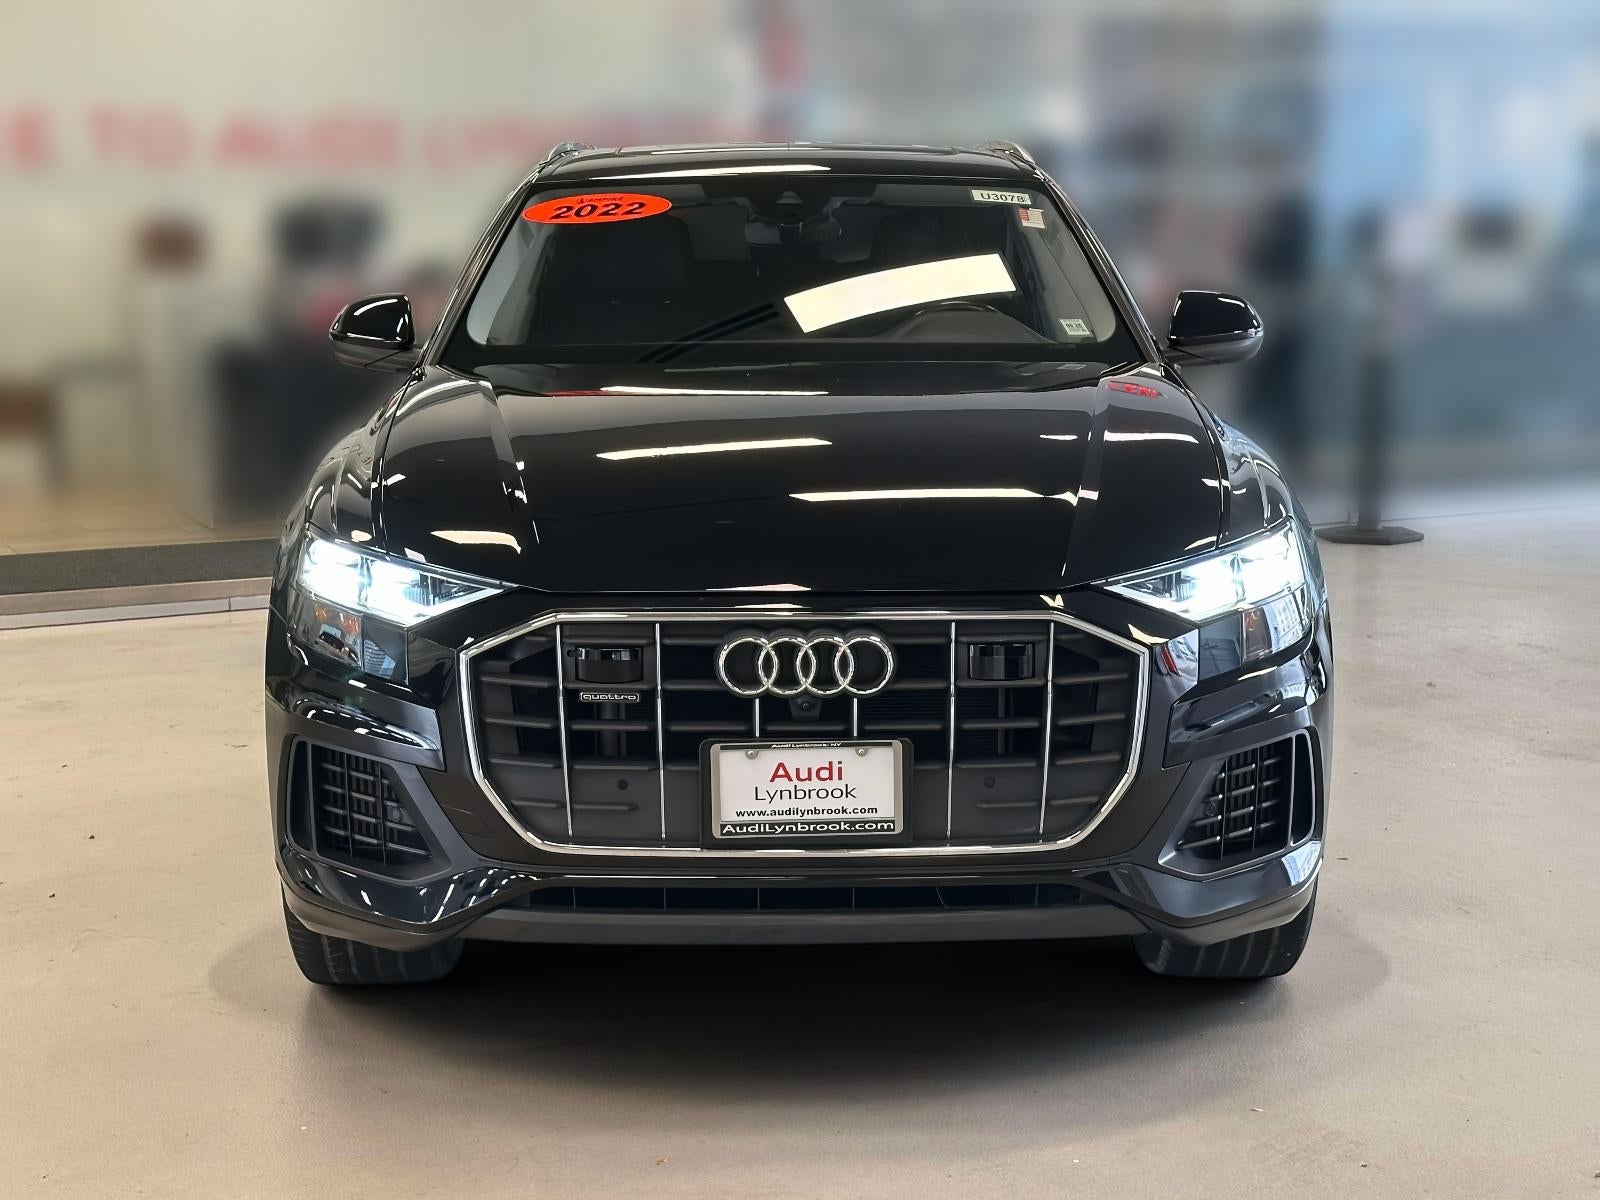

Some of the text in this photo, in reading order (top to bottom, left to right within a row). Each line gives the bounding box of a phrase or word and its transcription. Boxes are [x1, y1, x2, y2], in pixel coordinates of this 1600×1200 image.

[980, 193, 1025, 203] U3078
[549, 201, 647, 220] 2022
[583, 693, 637, 701] quattro
[769, 760, 843, 783] Audi
[754, 783, 857, 805] Lynbrook
[735, 806, 878, 818] www.audilynbrook.com
[722, 821, 895, 834] AudiLynbrook.com
